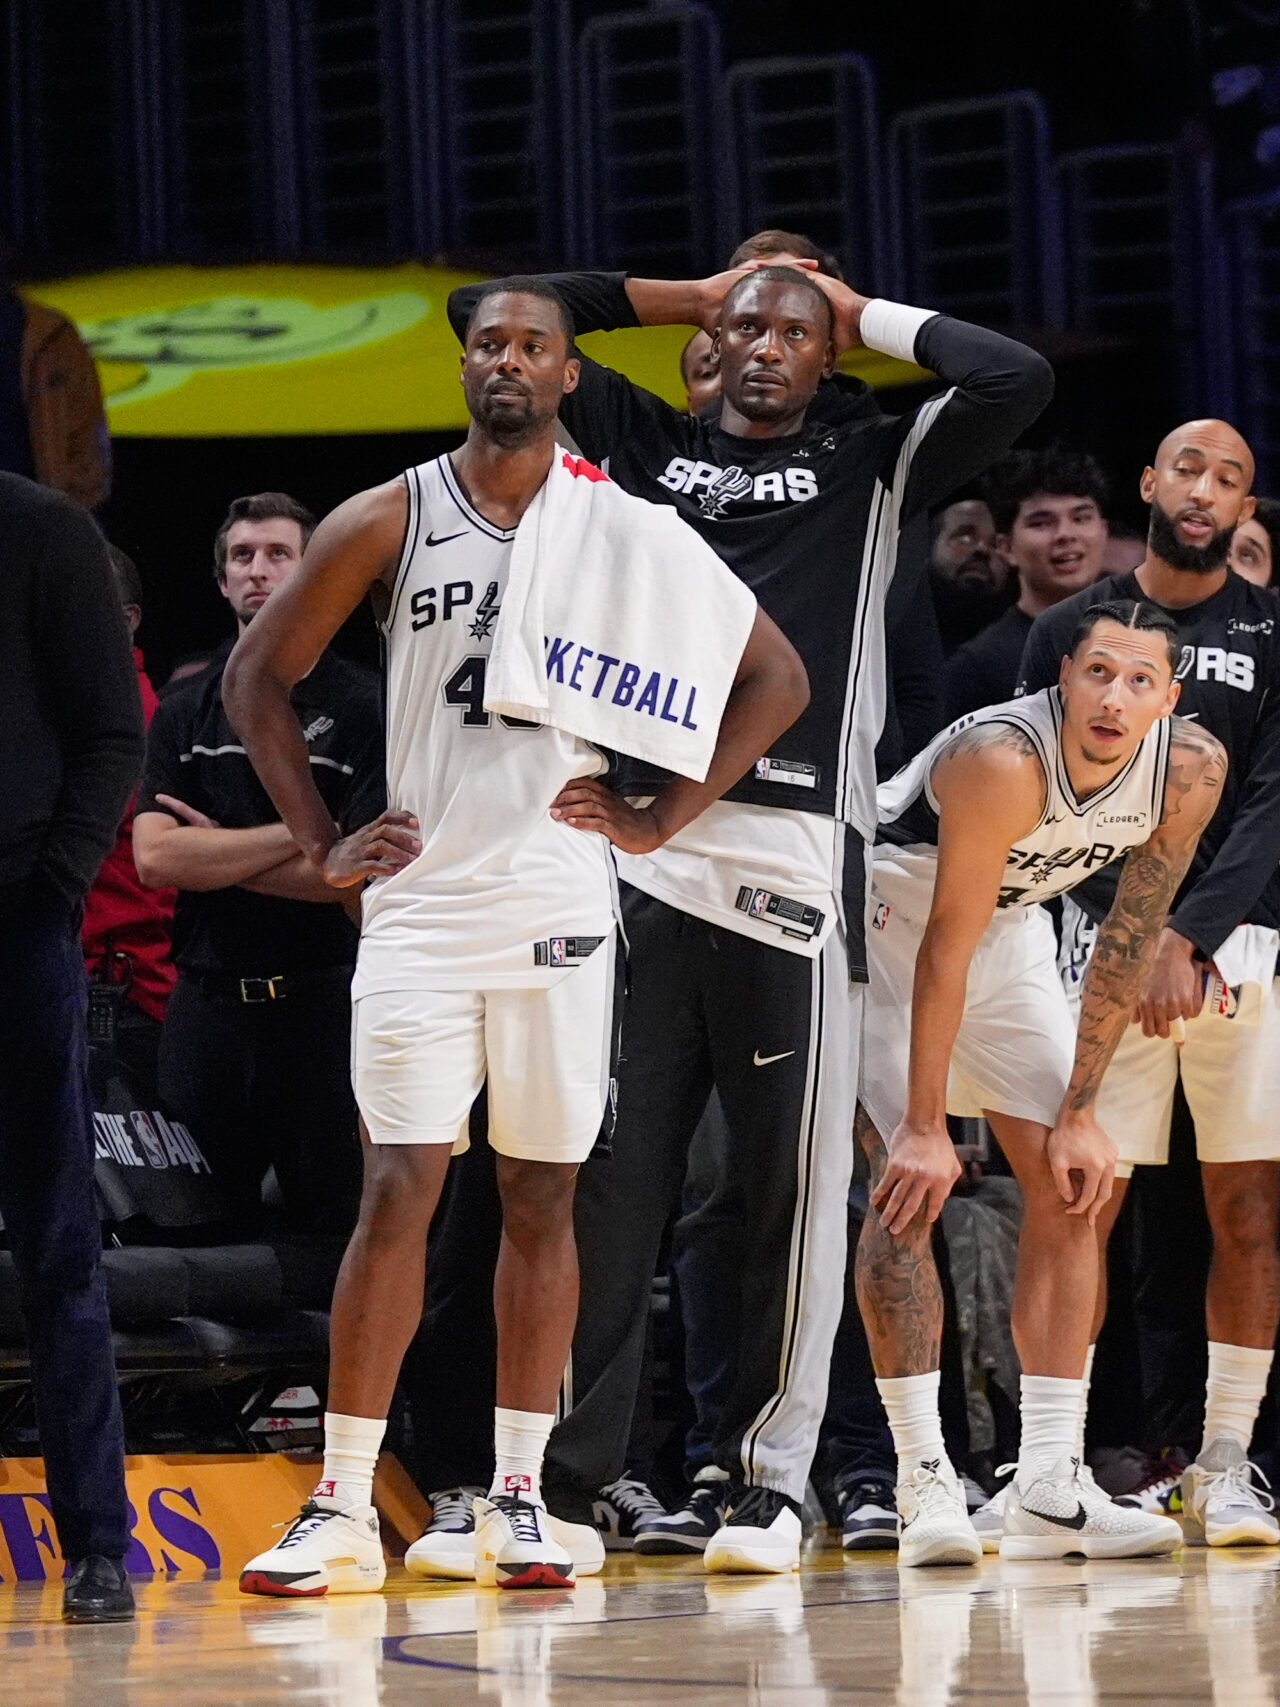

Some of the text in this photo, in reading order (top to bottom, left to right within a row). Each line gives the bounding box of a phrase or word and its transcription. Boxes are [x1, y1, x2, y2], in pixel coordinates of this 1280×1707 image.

[657, 457, 819, 521] SPURS
[544, 635, 698, 731] KETBALL
[1103, 815, 1140, 824] LEDGER
